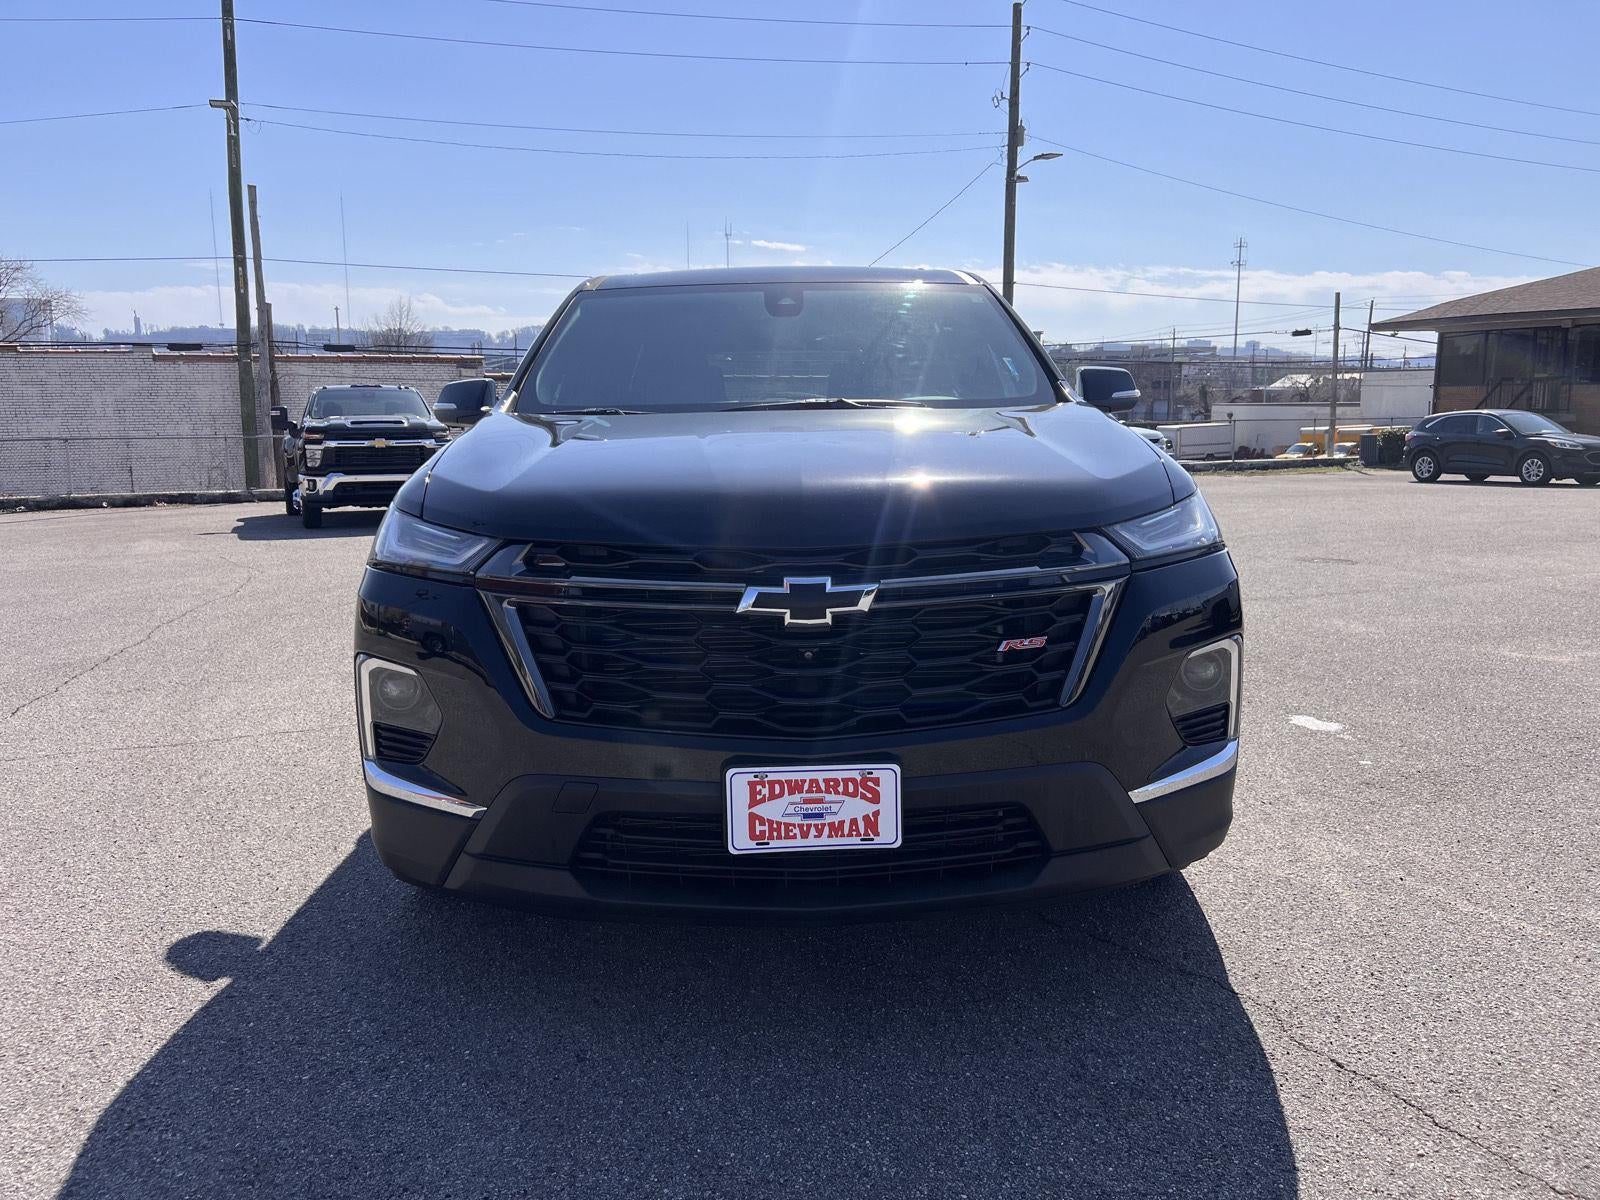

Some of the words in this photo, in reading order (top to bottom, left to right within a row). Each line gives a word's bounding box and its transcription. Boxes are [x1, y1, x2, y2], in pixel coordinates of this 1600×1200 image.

[997, 636, 1048, 652] RS
[747, 777, 881, 811] EDWARDS
[793, 805, 833, 813] Chevrolet
[748, 809, 881, 841] CHEVYMAN
